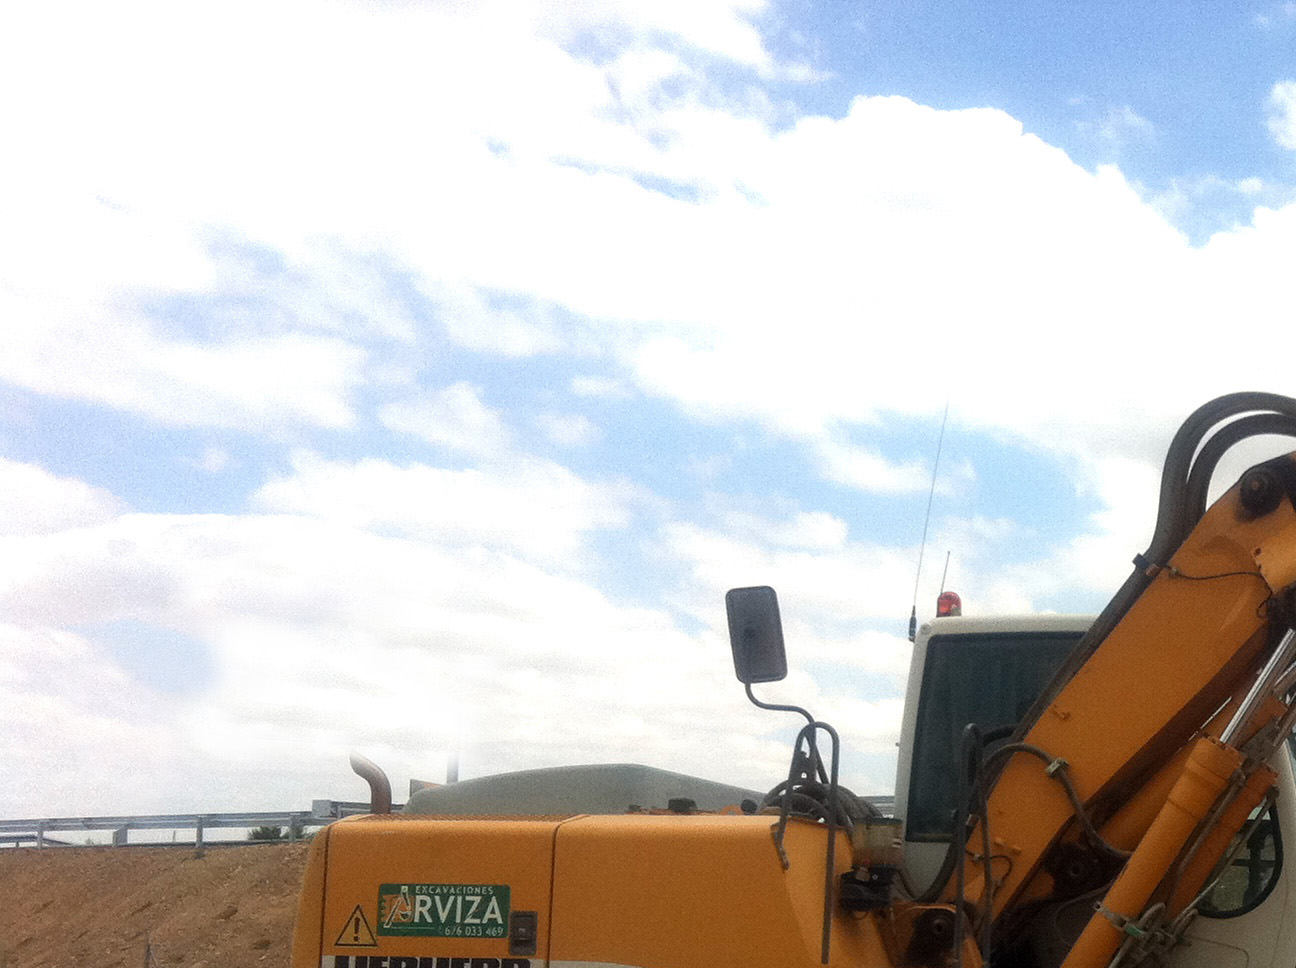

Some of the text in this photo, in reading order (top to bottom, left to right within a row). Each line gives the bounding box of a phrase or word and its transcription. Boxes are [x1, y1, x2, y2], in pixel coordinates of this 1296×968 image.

[415, 885, 494, 895] EXCAVACIONES
[383, 885, 504, 929] ARVIZA
[465, 926, 482, 937] 033
[485, 926, 504, 937] 469
